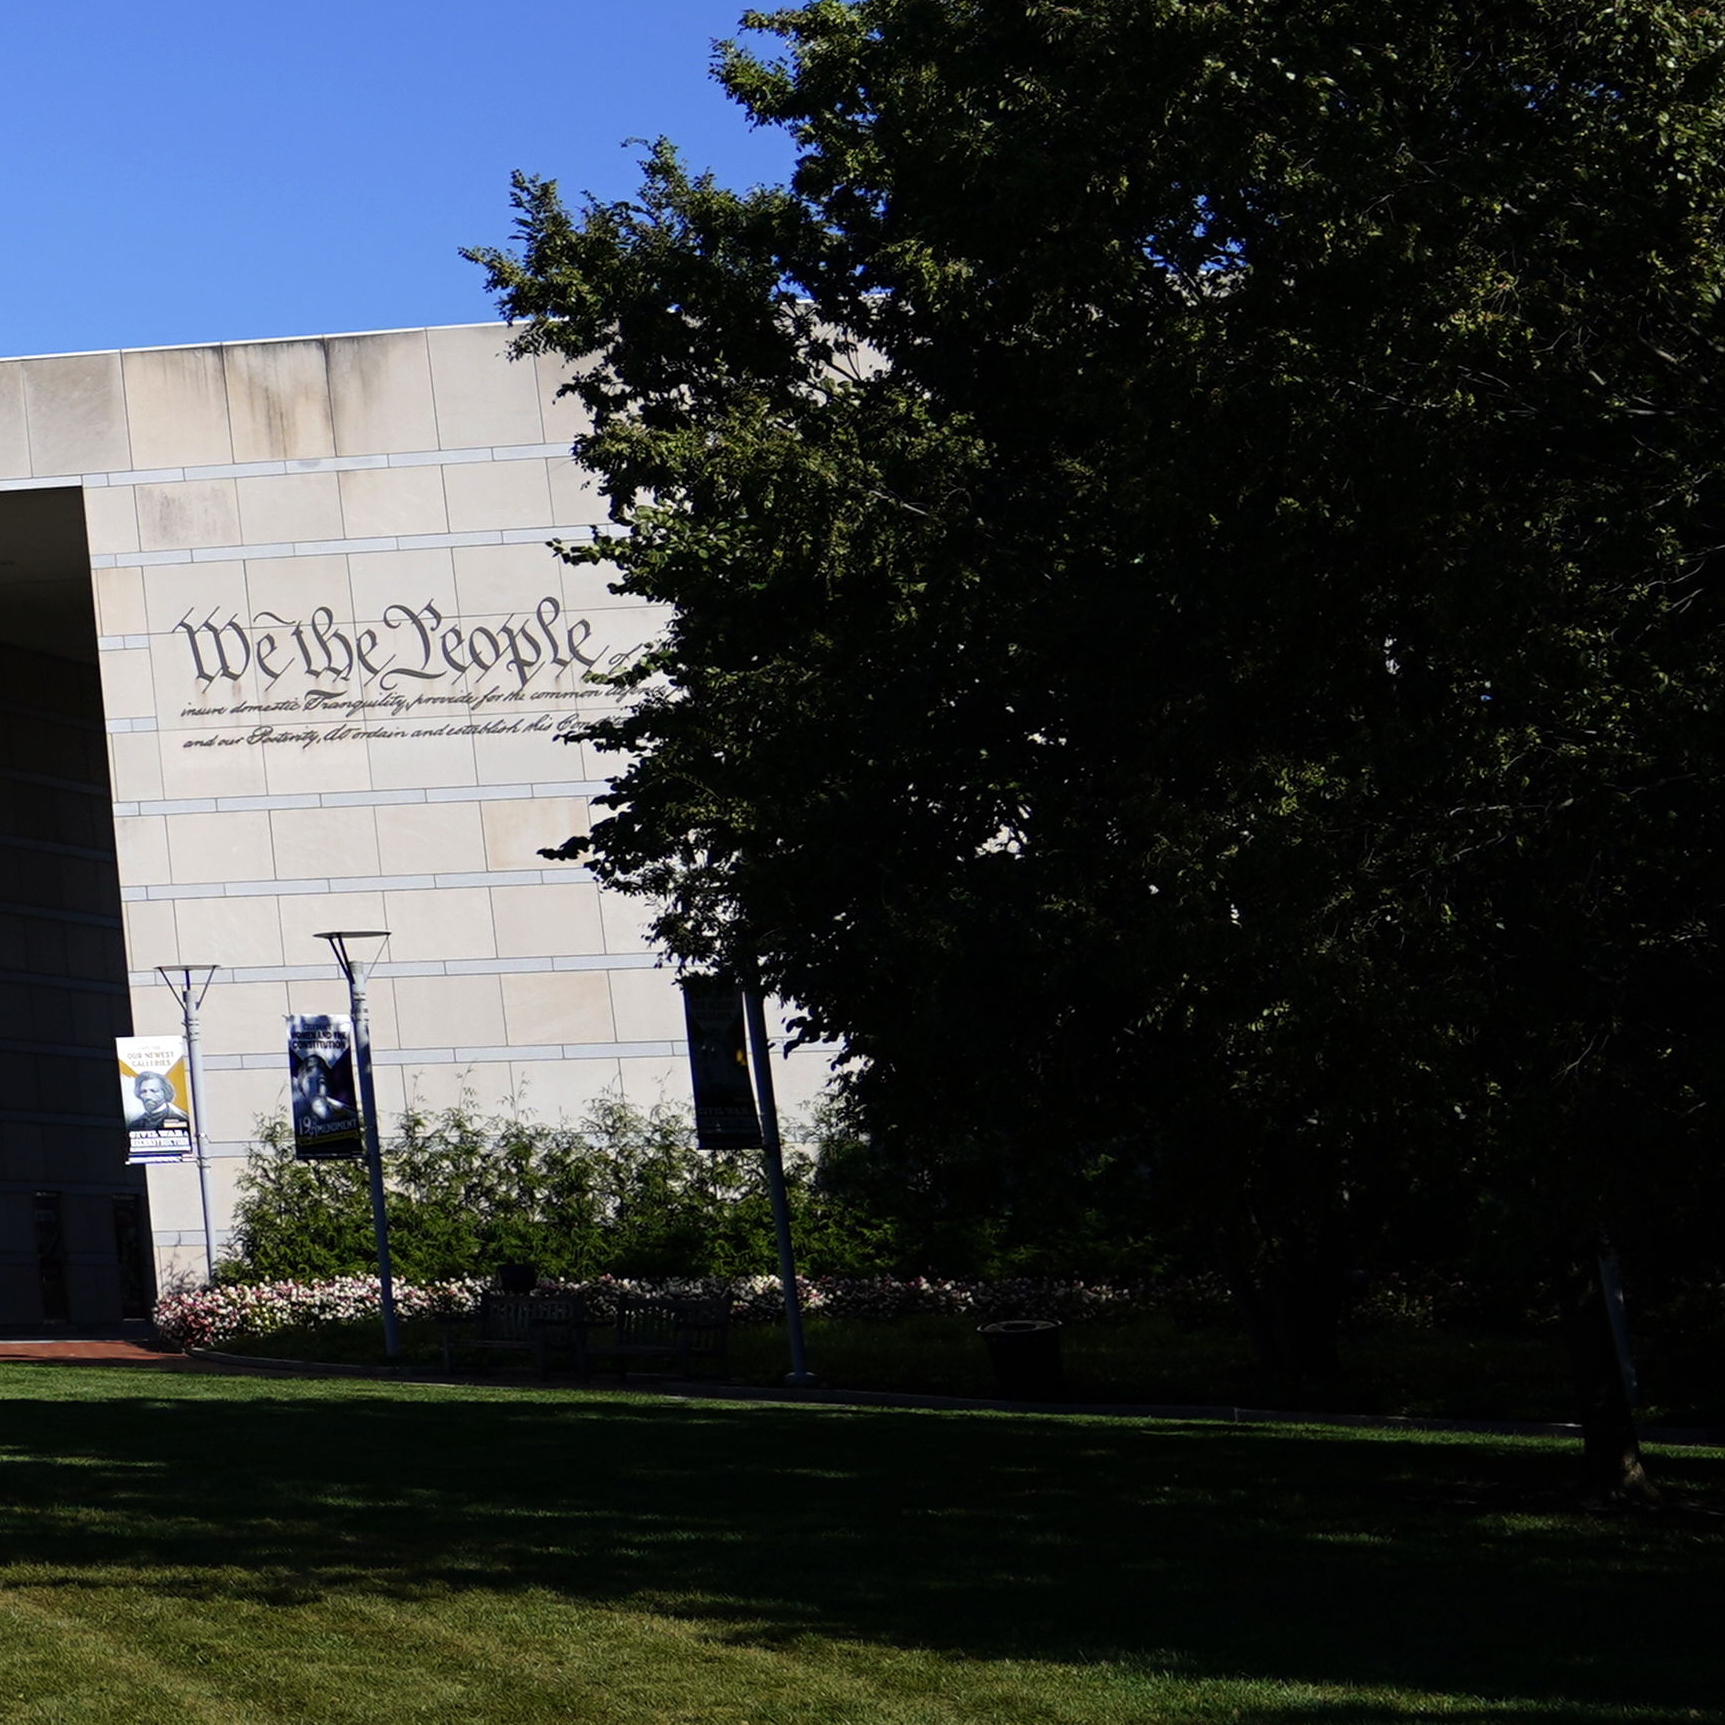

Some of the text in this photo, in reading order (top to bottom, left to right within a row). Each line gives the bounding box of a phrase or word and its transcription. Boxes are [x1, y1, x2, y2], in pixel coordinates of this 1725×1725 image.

[171, 606, 295, 694] We
[291, 606, 397, 687] the
[380, 596, 609, 691] People
[181, 702, 227, 717] insure
[230, 697, 301, 714] domestic
[406, 690, 477, 711] provide
[471, 685, 503, 710] for
[503, 690, 525, 702] the
[530, 687, 602, 702] common
[183, 735, 218, 748] and
[218, 737, 243, 747] our
[352, 726, 408, 739] ordain
[410, 724, 446, 737] and
[446, 719, 521, 736] establish
[522, 714, 553, 733] this
[144, 1051, 174, 1059] NEWEST
[291, 1040, 346, 1049] CONSTITUTION
